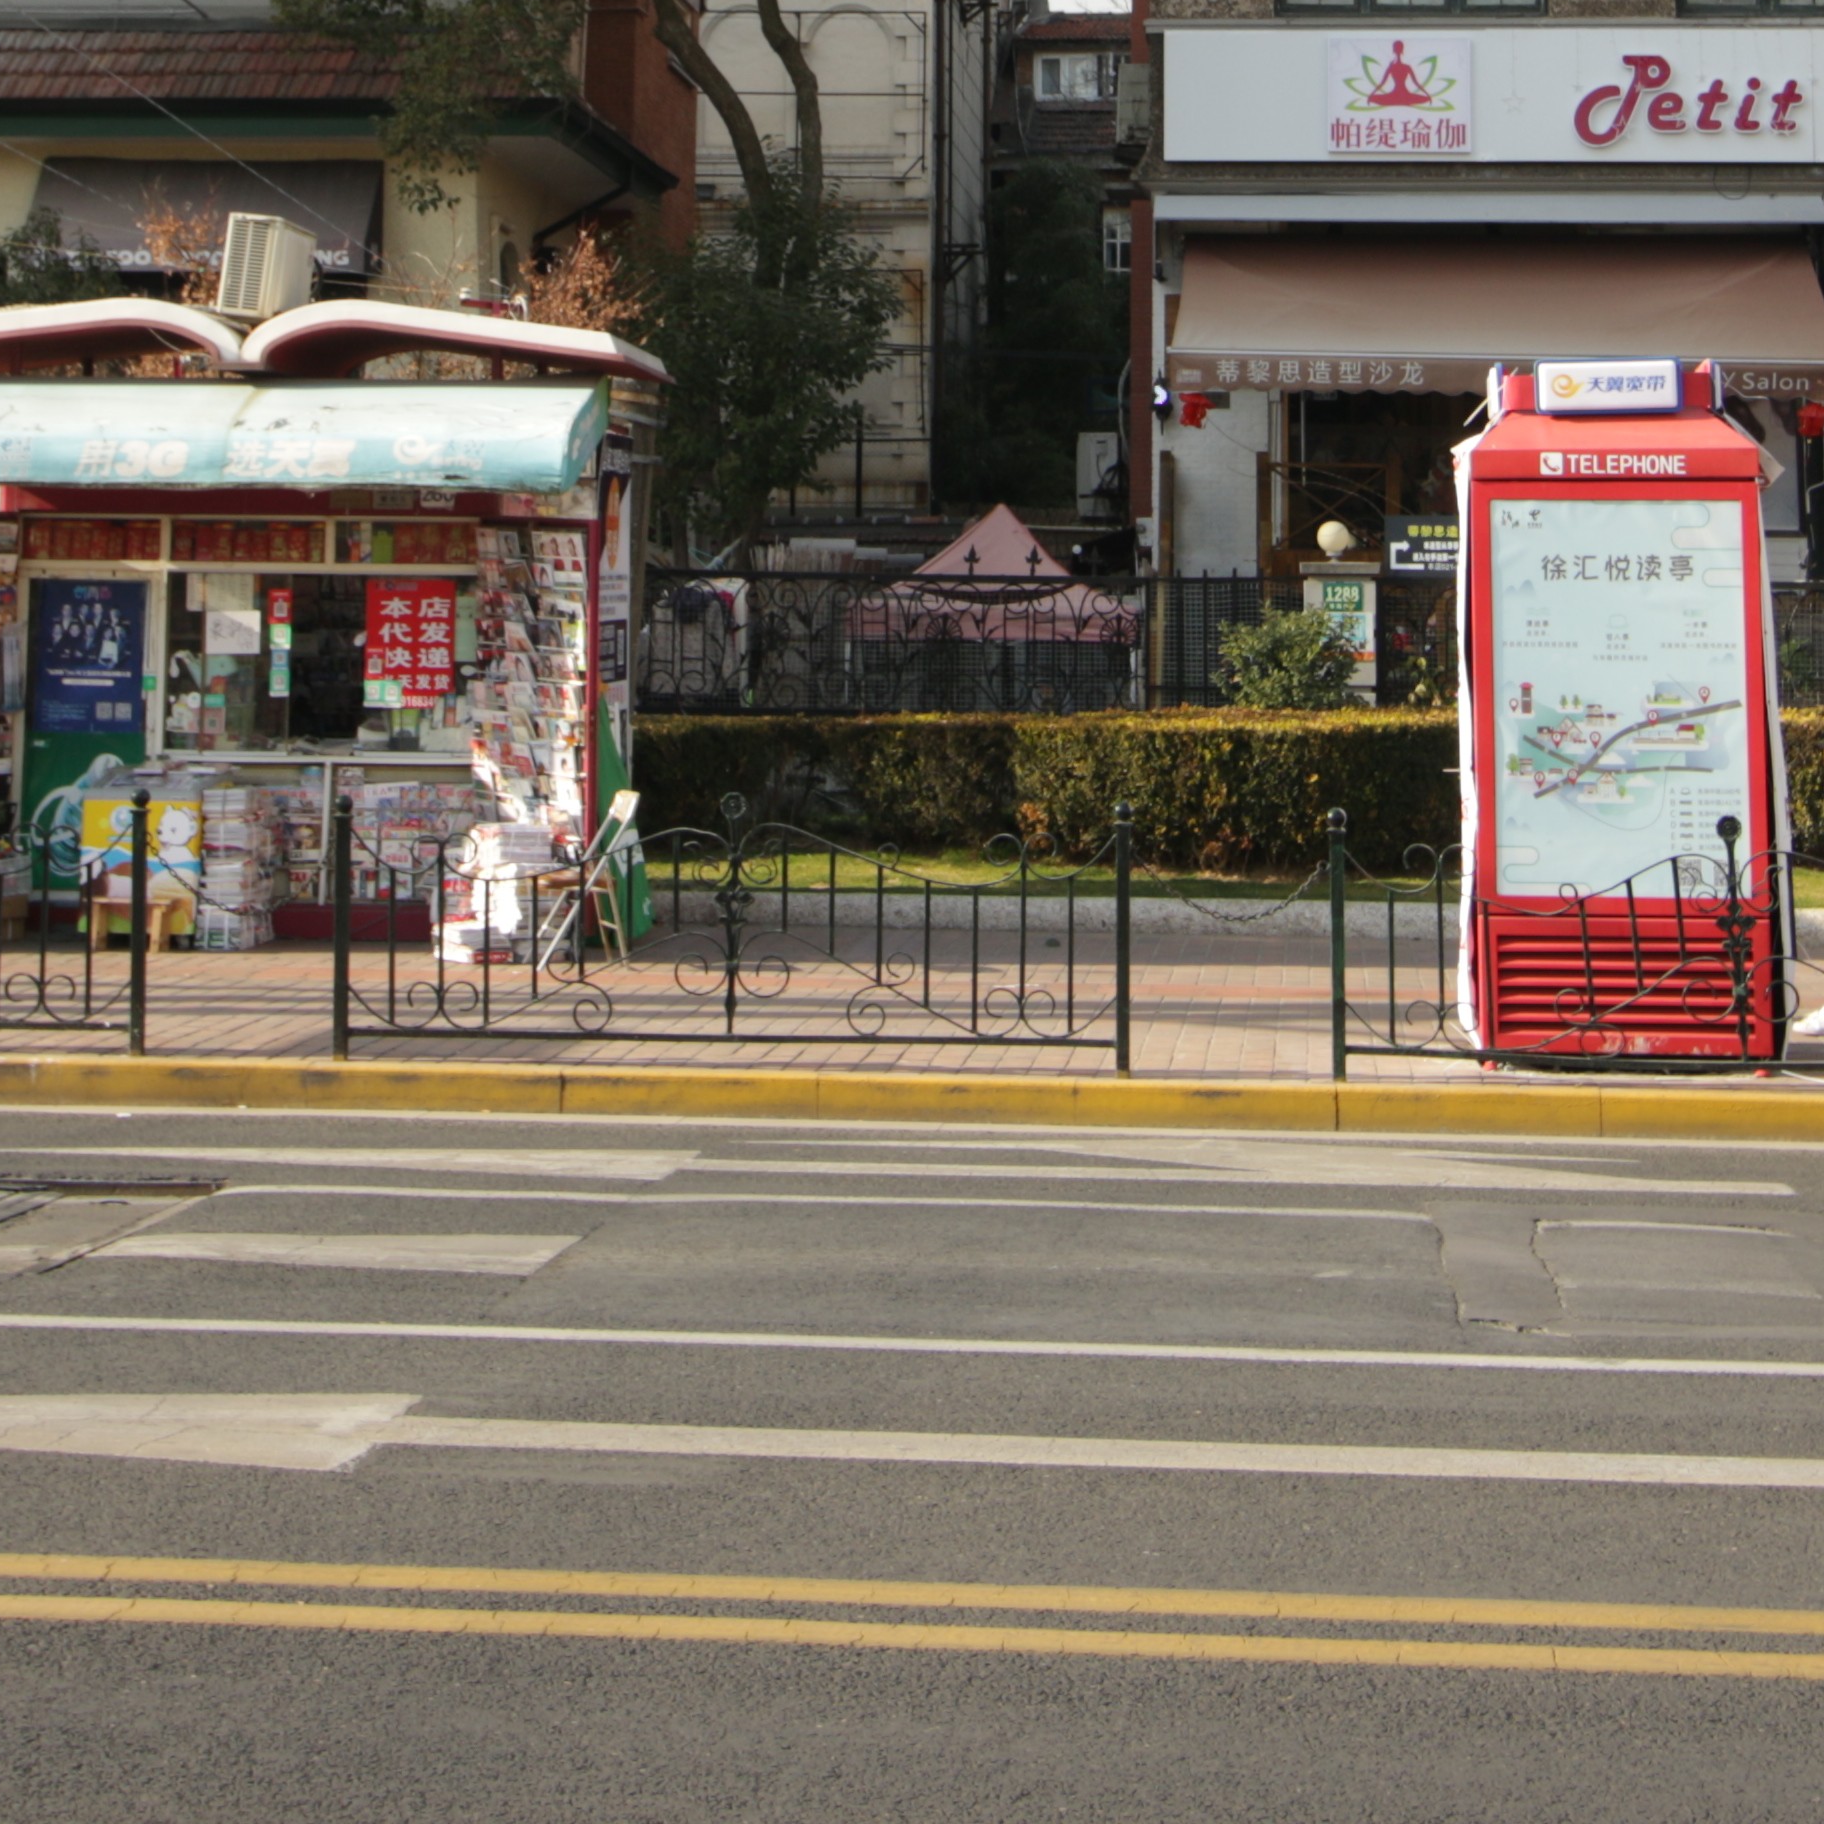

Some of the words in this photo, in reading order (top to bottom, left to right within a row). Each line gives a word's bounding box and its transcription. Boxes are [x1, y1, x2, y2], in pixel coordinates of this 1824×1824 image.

[1574, 55, 1802, 146] Petit
[1330, 118, 1467, 150] 帕缇瑜伽
[1217, 359, 1424, 387] 蒂黎思造型沙龙
[1587, 374, 1667, 394] 天翼宽带
[1742, 371, 1811, 392] Salon
[1567, 454, 1687, 475] TELEPHONE
[1541, 554, 1694, 582] 徐汇悦读亭
[1326, 585, 1360, 602] 1288
[380, 596, 451, 618] 本店
[379, 622, 451, 644] 代发
[385, 646, 451, 669] 快递
